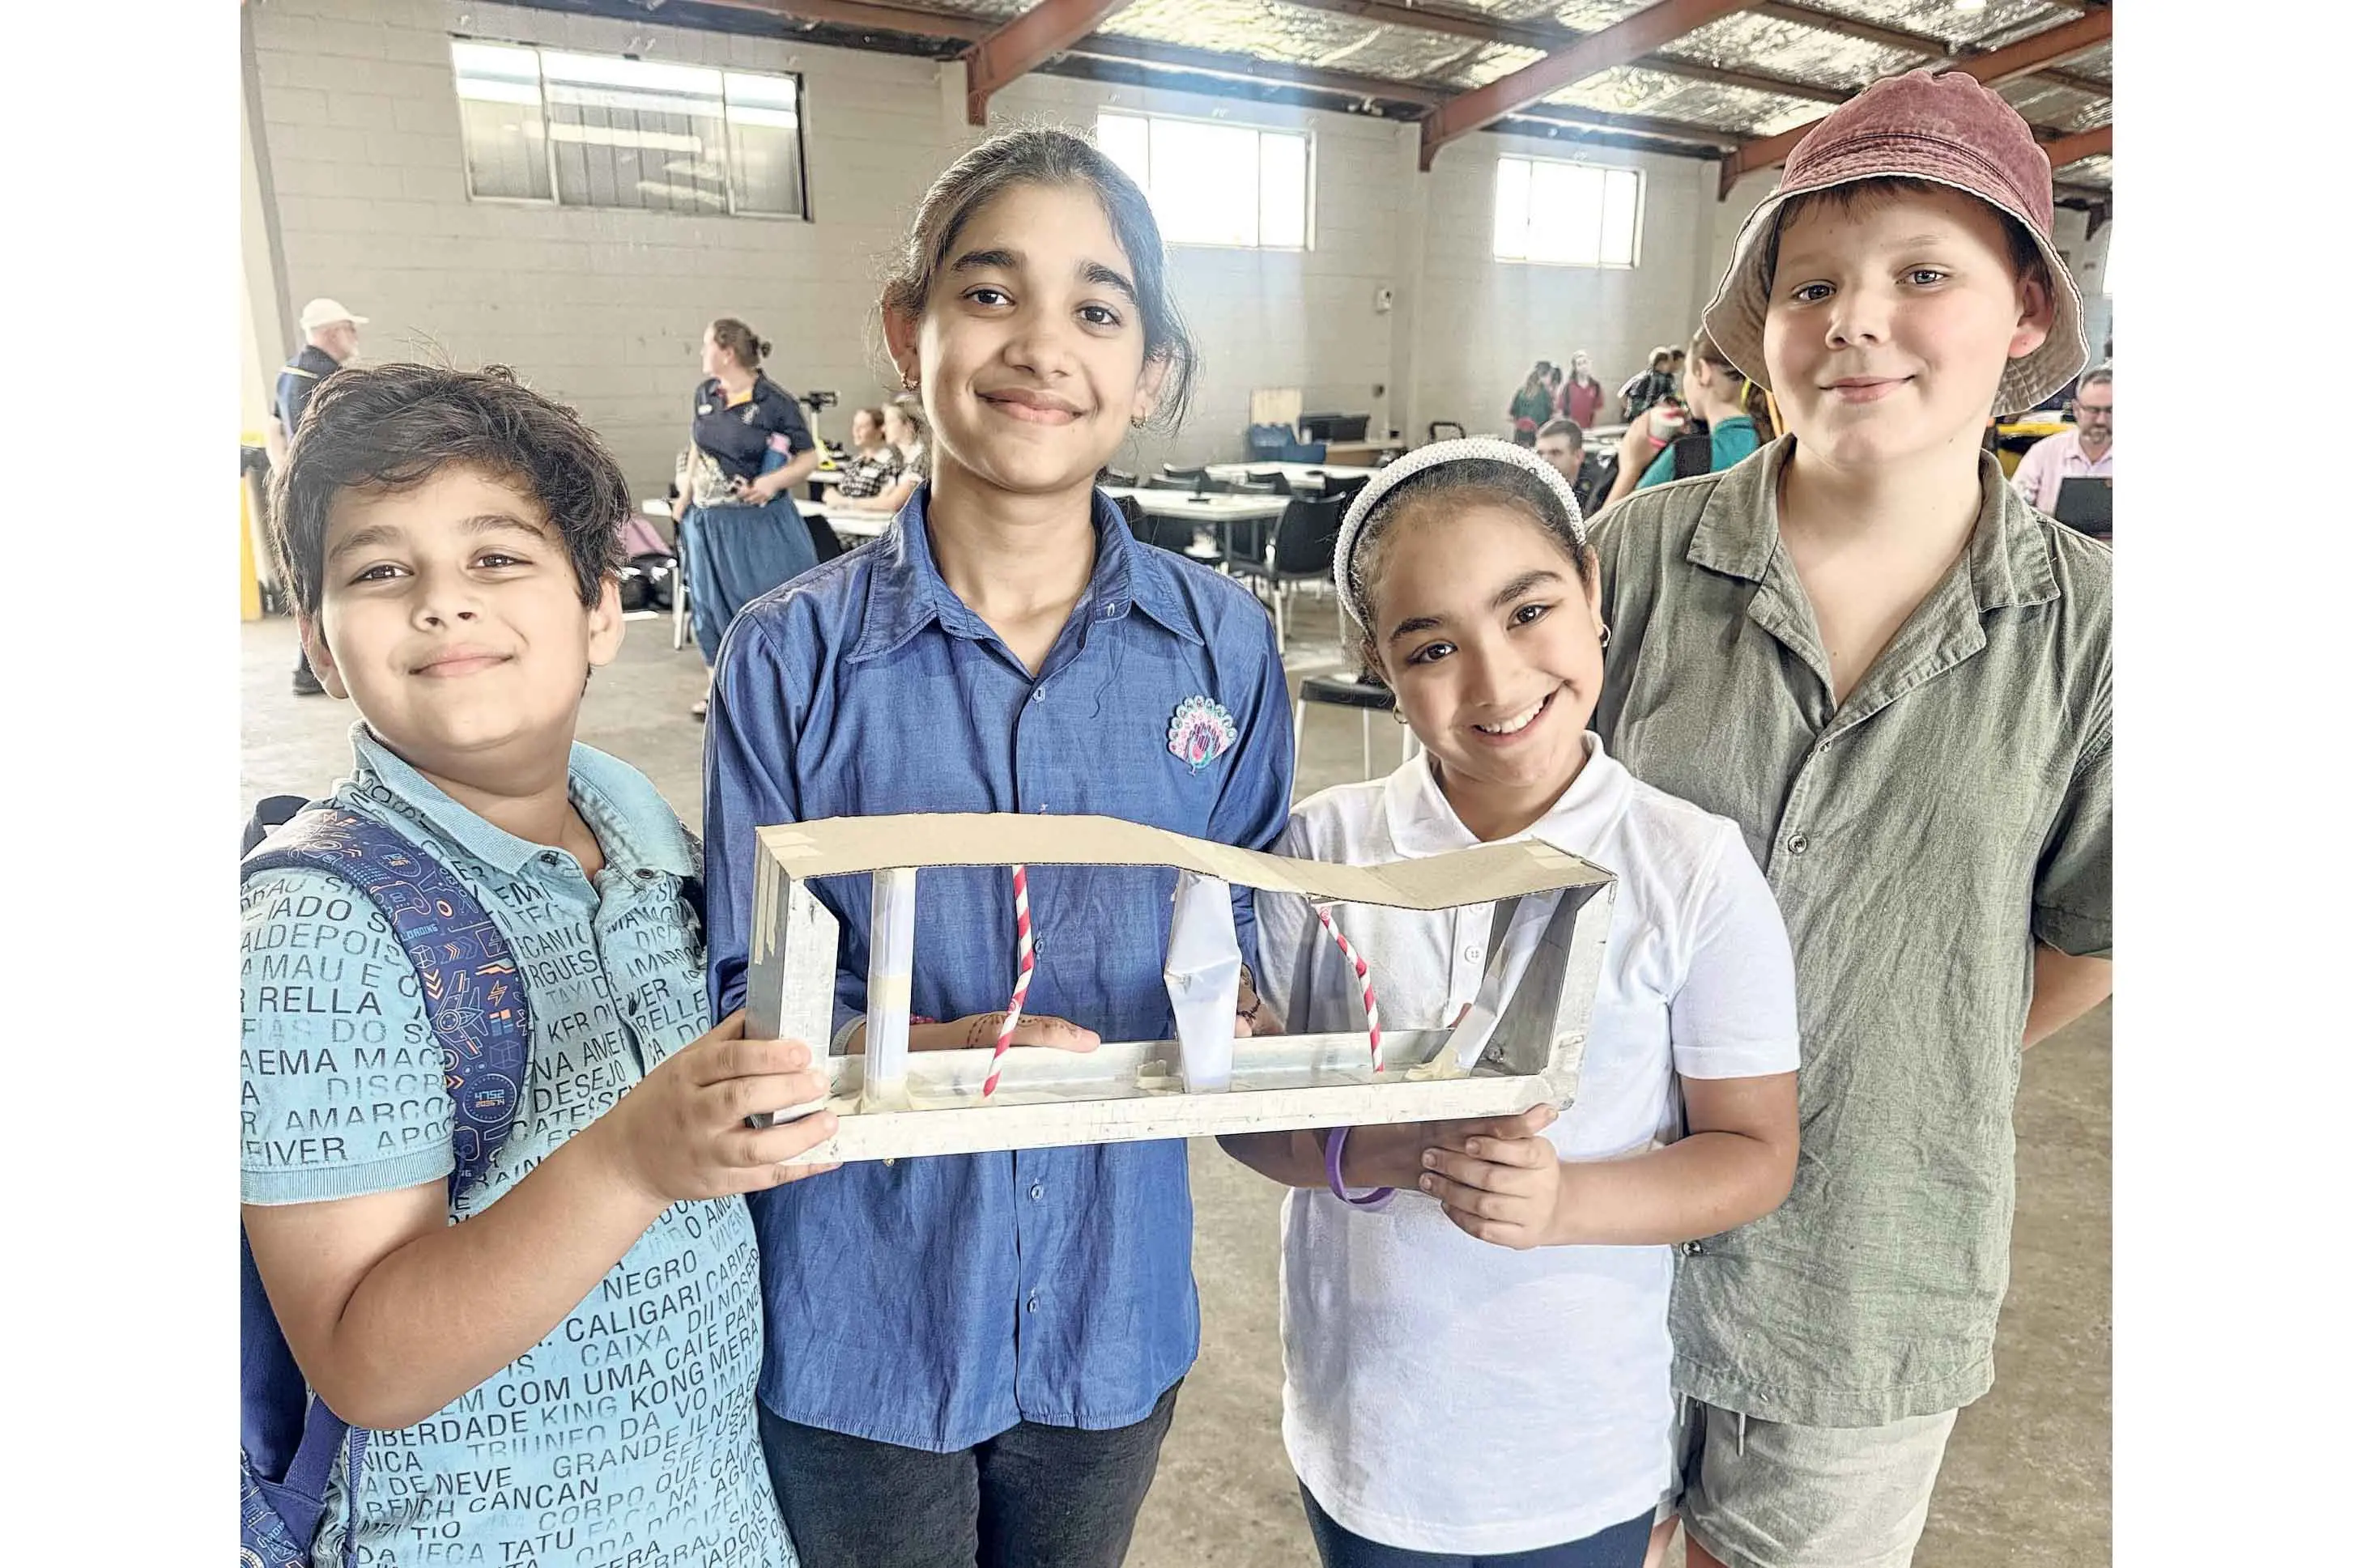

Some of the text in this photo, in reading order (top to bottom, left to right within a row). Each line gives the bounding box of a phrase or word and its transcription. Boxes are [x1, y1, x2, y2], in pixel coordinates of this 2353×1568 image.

[259, 986, 381, 1015] RELLA
[534, 1060, 626, 1114] DESEJO
[603, 1249, 697, 1302] NEGRO
[566, 1280, 701, 1343] CALIGARI
[581, 1325, 671, 1368] CAIXA
[497, 1376, 571, 1409] COM
[584, 1358, 656, 1396] UMA
[541, 1396, 617, 1427] KING
[631, 1362, 704, 1413] KONG
[620, 1412, 661, 1441] DA
[435, 1466, 513, 1497] NEVE
[553, 1425, 680, 1479] GRANDE
[468, 1476, 598, 1514] CANCAN
[411, 1520, 462, 1540] TIO
[498, 1526, 575, 1562] TATU
